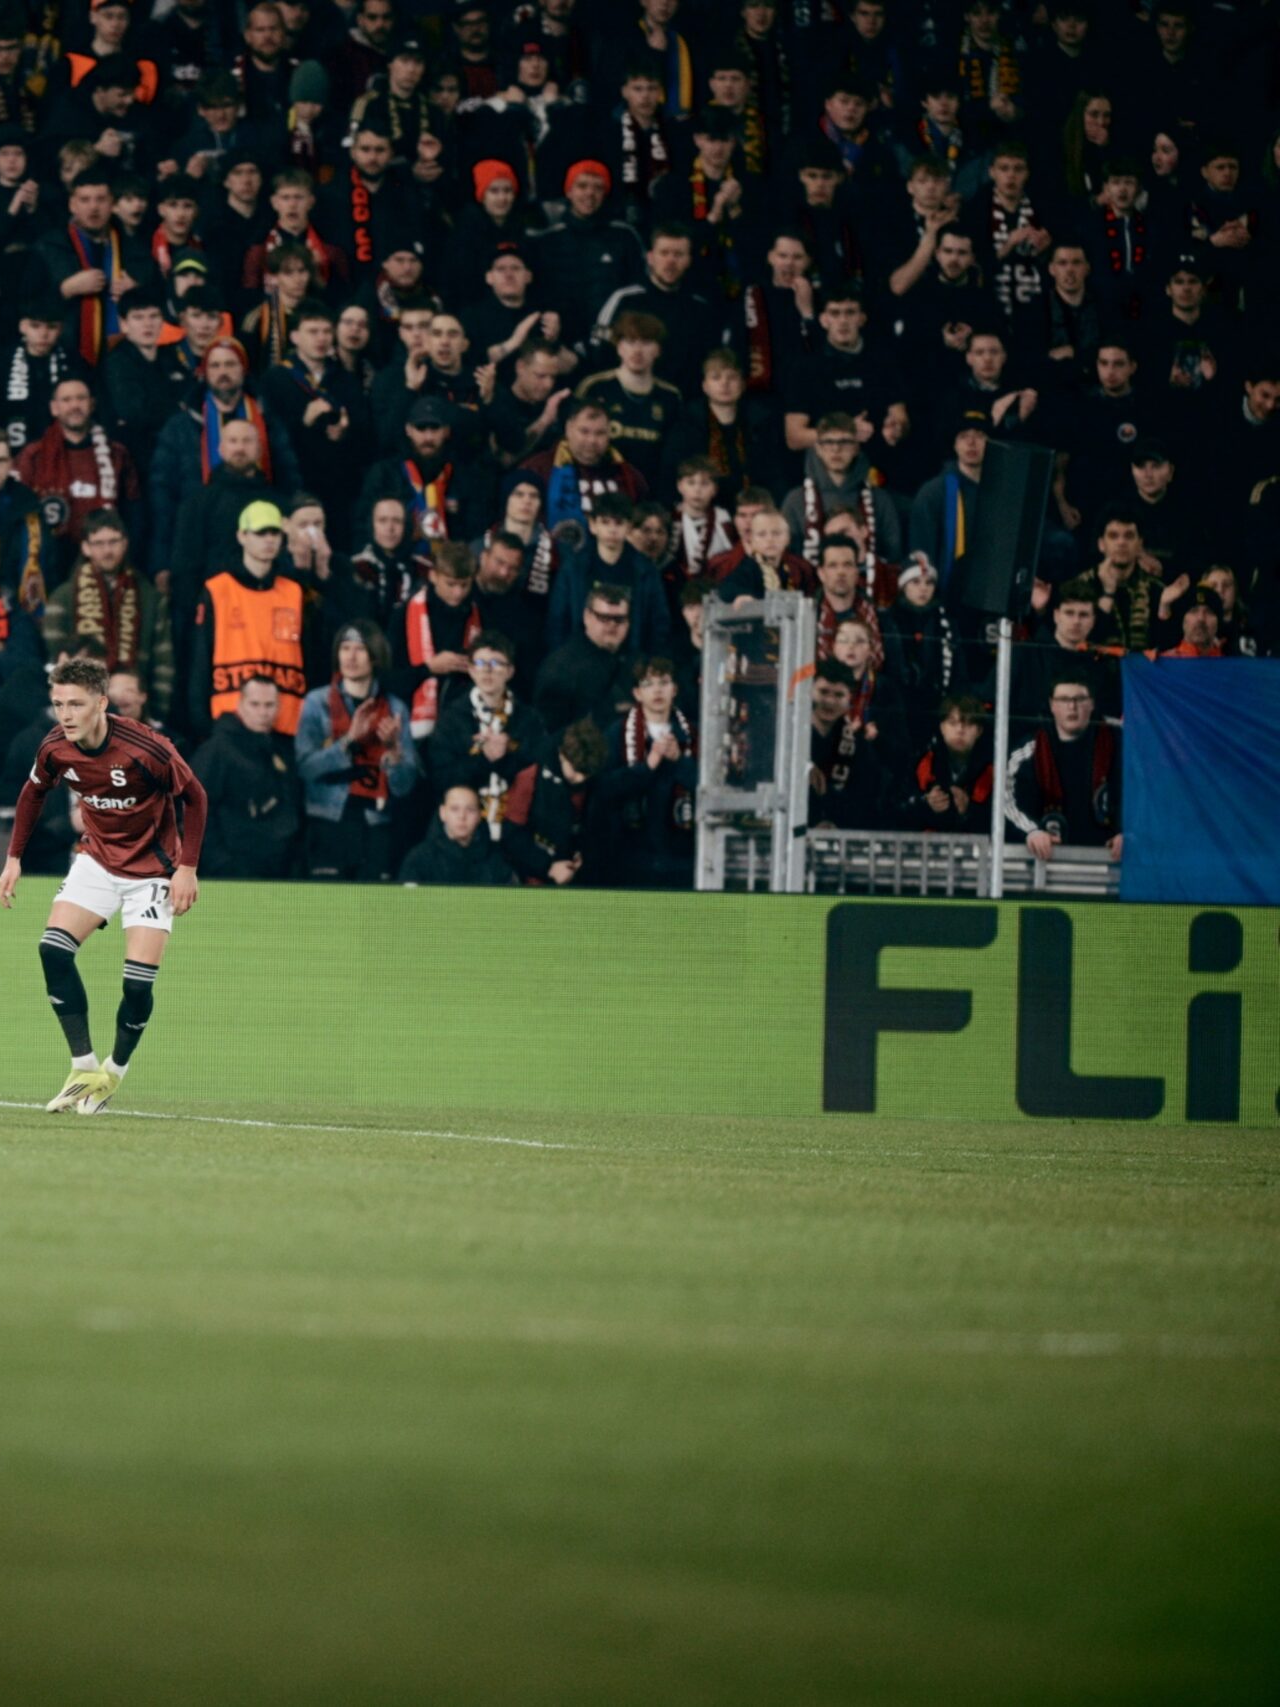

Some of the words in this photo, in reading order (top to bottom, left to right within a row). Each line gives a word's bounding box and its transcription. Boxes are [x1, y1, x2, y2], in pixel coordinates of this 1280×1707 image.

[111, 769, 128, 787] S
[72, 789, 137, 810] etano
[823, 902, 1280, 1122] FLi
